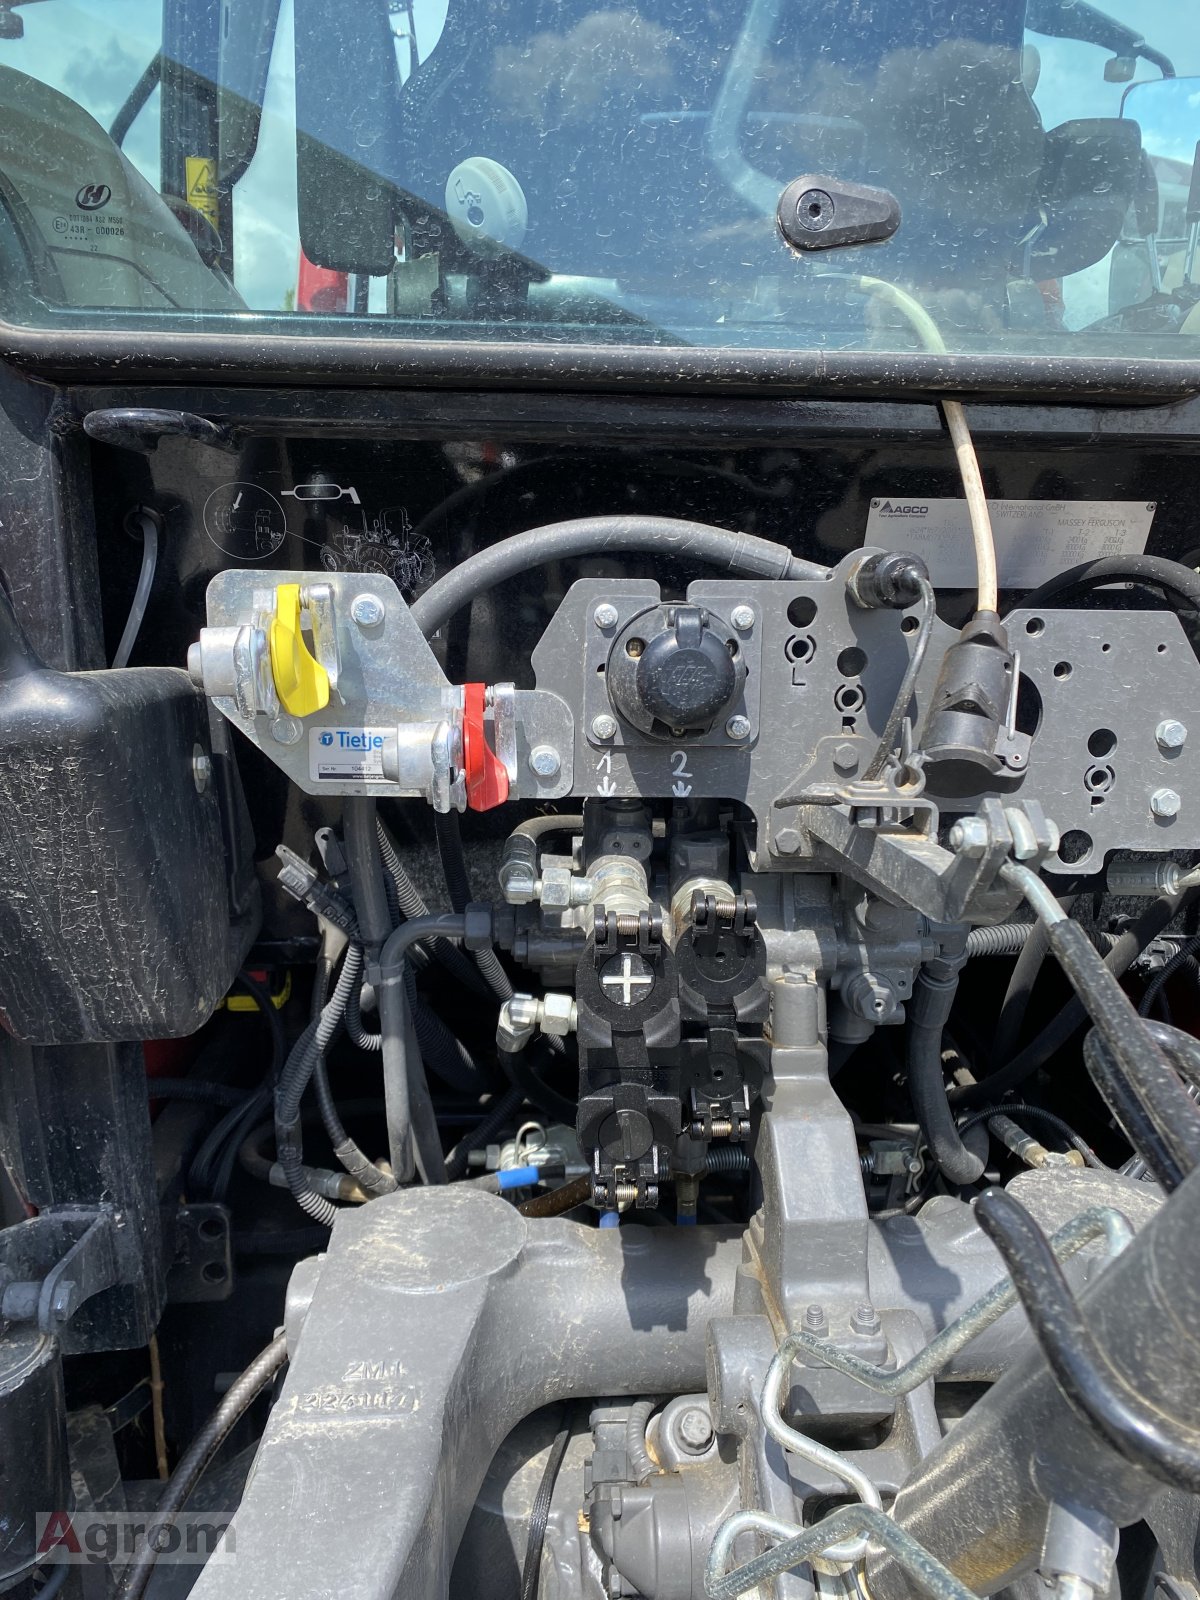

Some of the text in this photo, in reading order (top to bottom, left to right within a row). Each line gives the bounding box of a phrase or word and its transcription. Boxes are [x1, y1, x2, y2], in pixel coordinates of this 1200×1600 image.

[70, 225, 85, 234] 43R
[893, 506, 929, 514] AGCO
[1000, 502, 1044, 511] International
[996, 511, 1043, 519] SWITZERLAND
[1057, 519, 1126, 527] MASSEY FERGUSON
[792, 667, 806, 686] L
[842, 716, 856, 734] R
[596, 751, 611, 773] 1
[670, 751, 693, 777] 2
